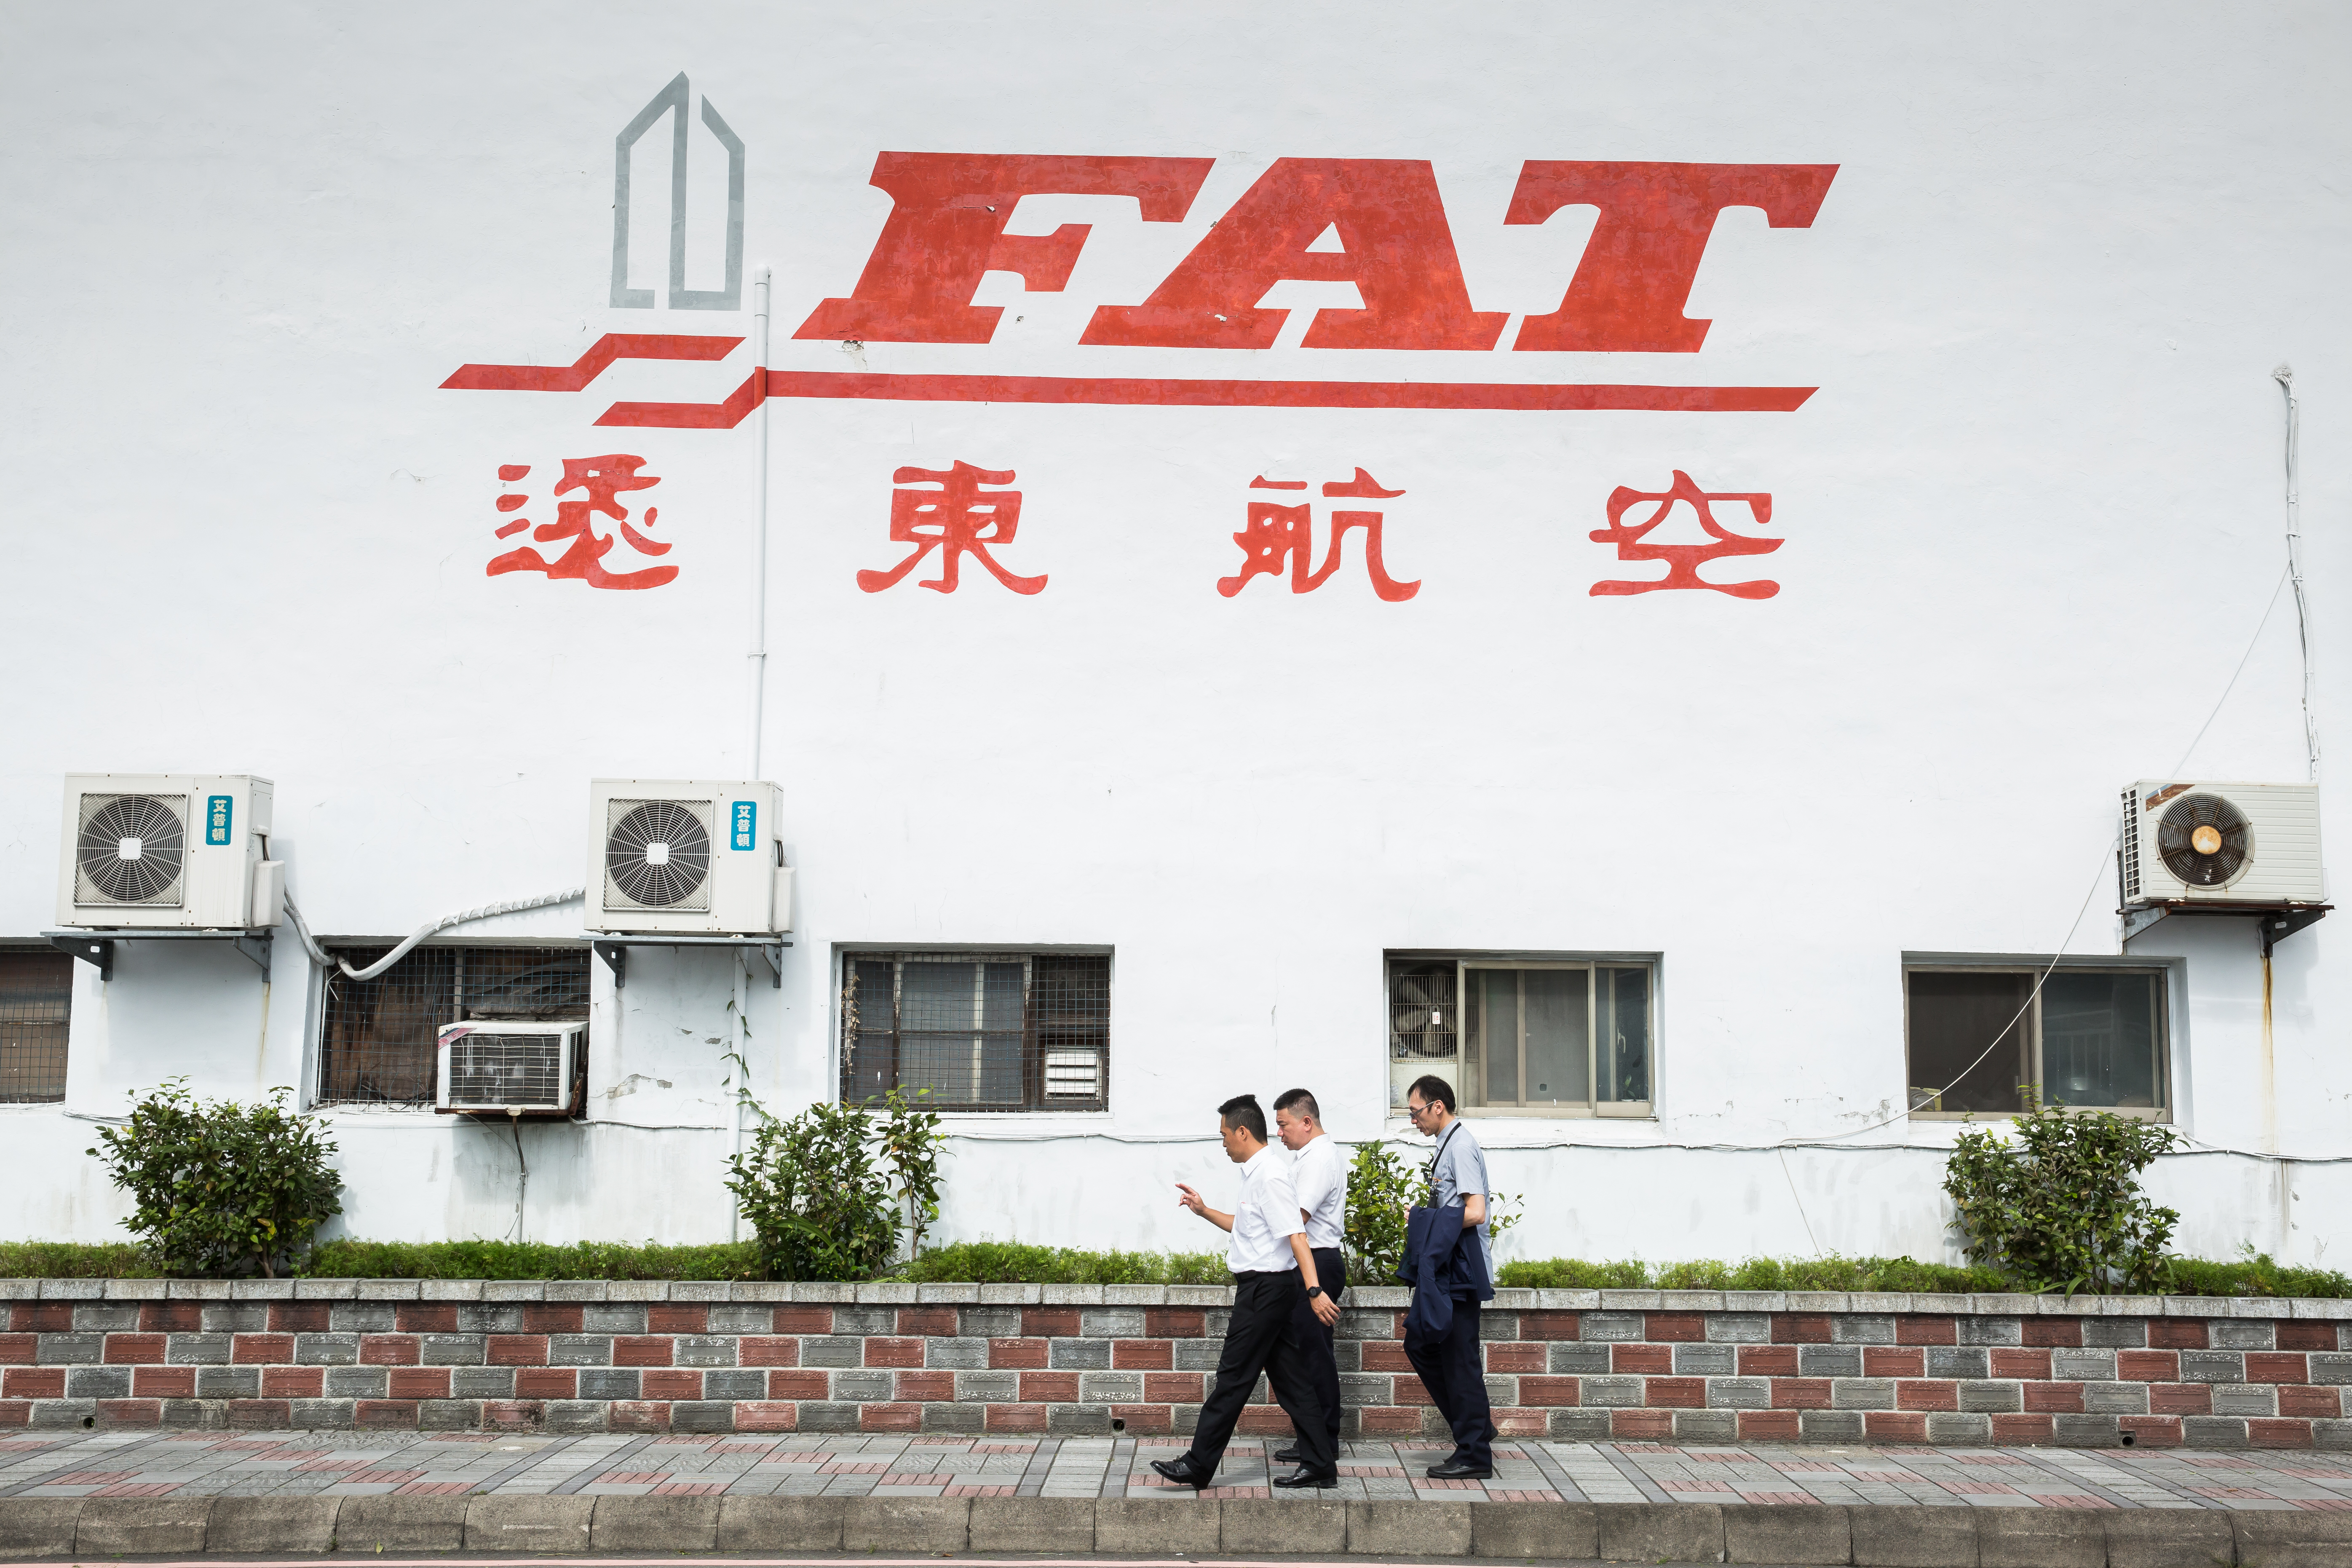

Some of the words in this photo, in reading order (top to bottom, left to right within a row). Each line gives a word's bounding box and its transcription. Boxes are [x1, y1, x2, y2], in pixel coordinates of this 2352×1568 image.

[792, 152, 1839, 353] FAT
[487, 454, 1784, 602] 遠東航空
[212, 799, 227, 841] 艾普頓
[736, 805, 751, 847] 艾普頓
